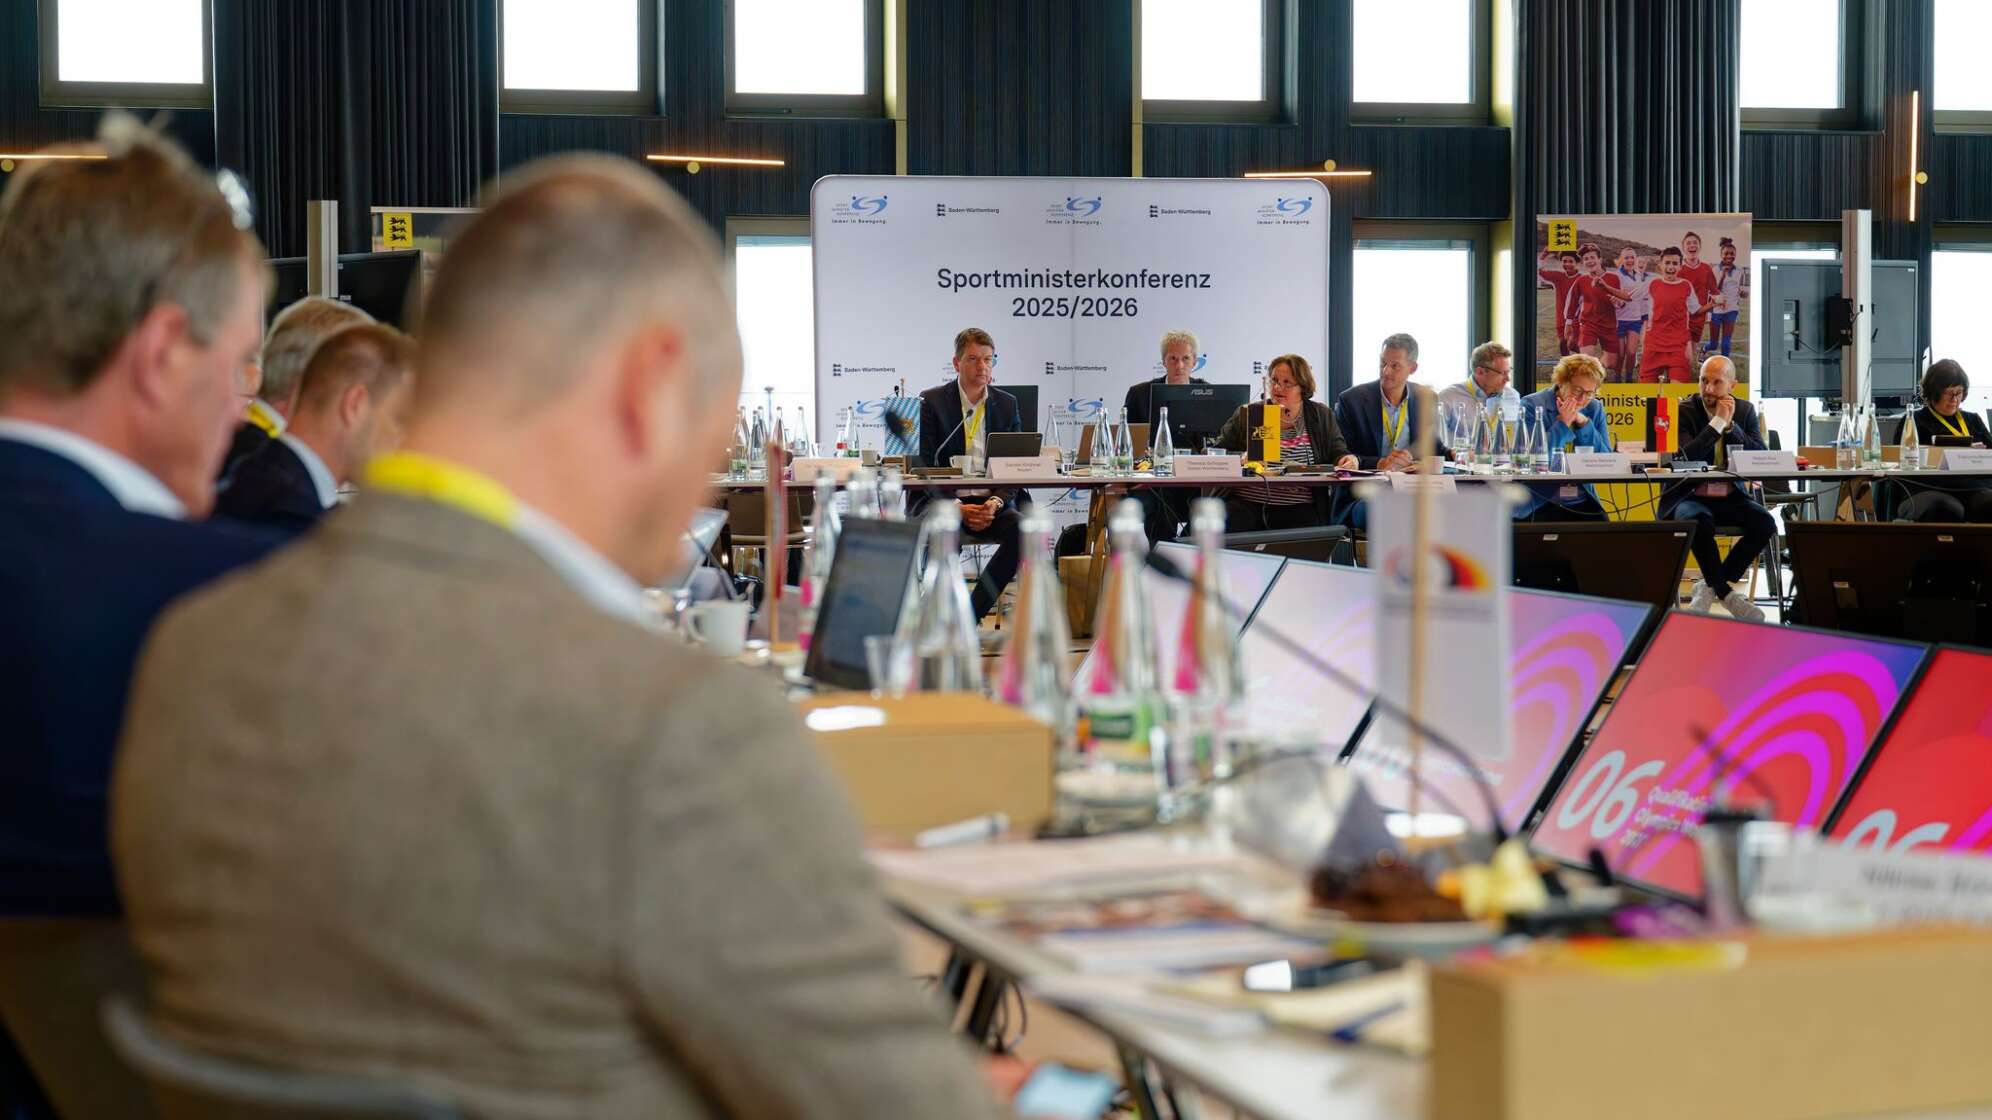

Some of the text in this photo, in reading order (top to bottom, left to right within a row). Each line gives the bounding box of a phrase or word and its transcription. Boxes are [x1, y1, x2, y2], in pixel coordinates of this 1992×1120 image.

[937, 268, 1211, 293] Sportministerkonferenz
[1012, 296, 1138, 319] 2025/2026
[1557, 750, 1666, 839] 06
